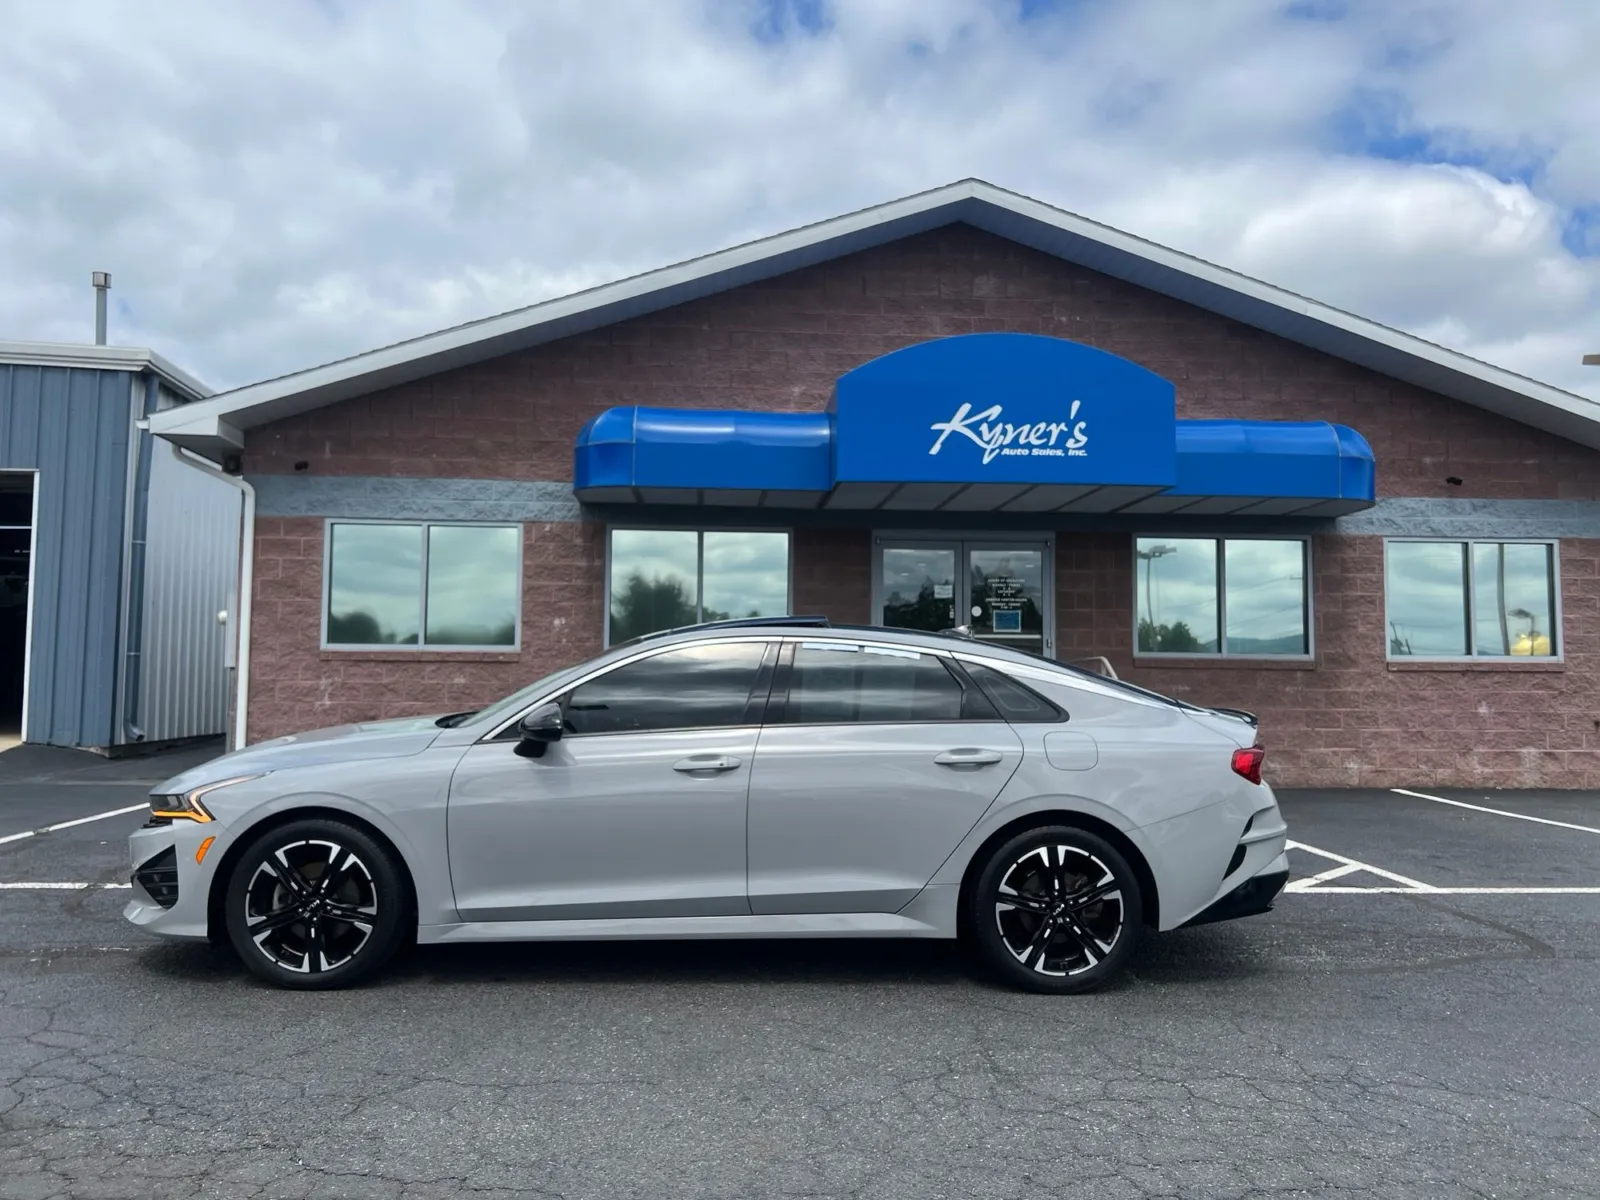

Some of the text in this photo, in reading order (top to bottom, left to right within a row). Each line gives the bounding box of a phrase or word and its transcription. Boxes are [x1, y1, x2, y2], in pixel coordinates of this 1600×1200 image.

[929, 400, 1088, 465] Kyner's
[1001, 448, 1088, 457] Auto Sales, Inc.
